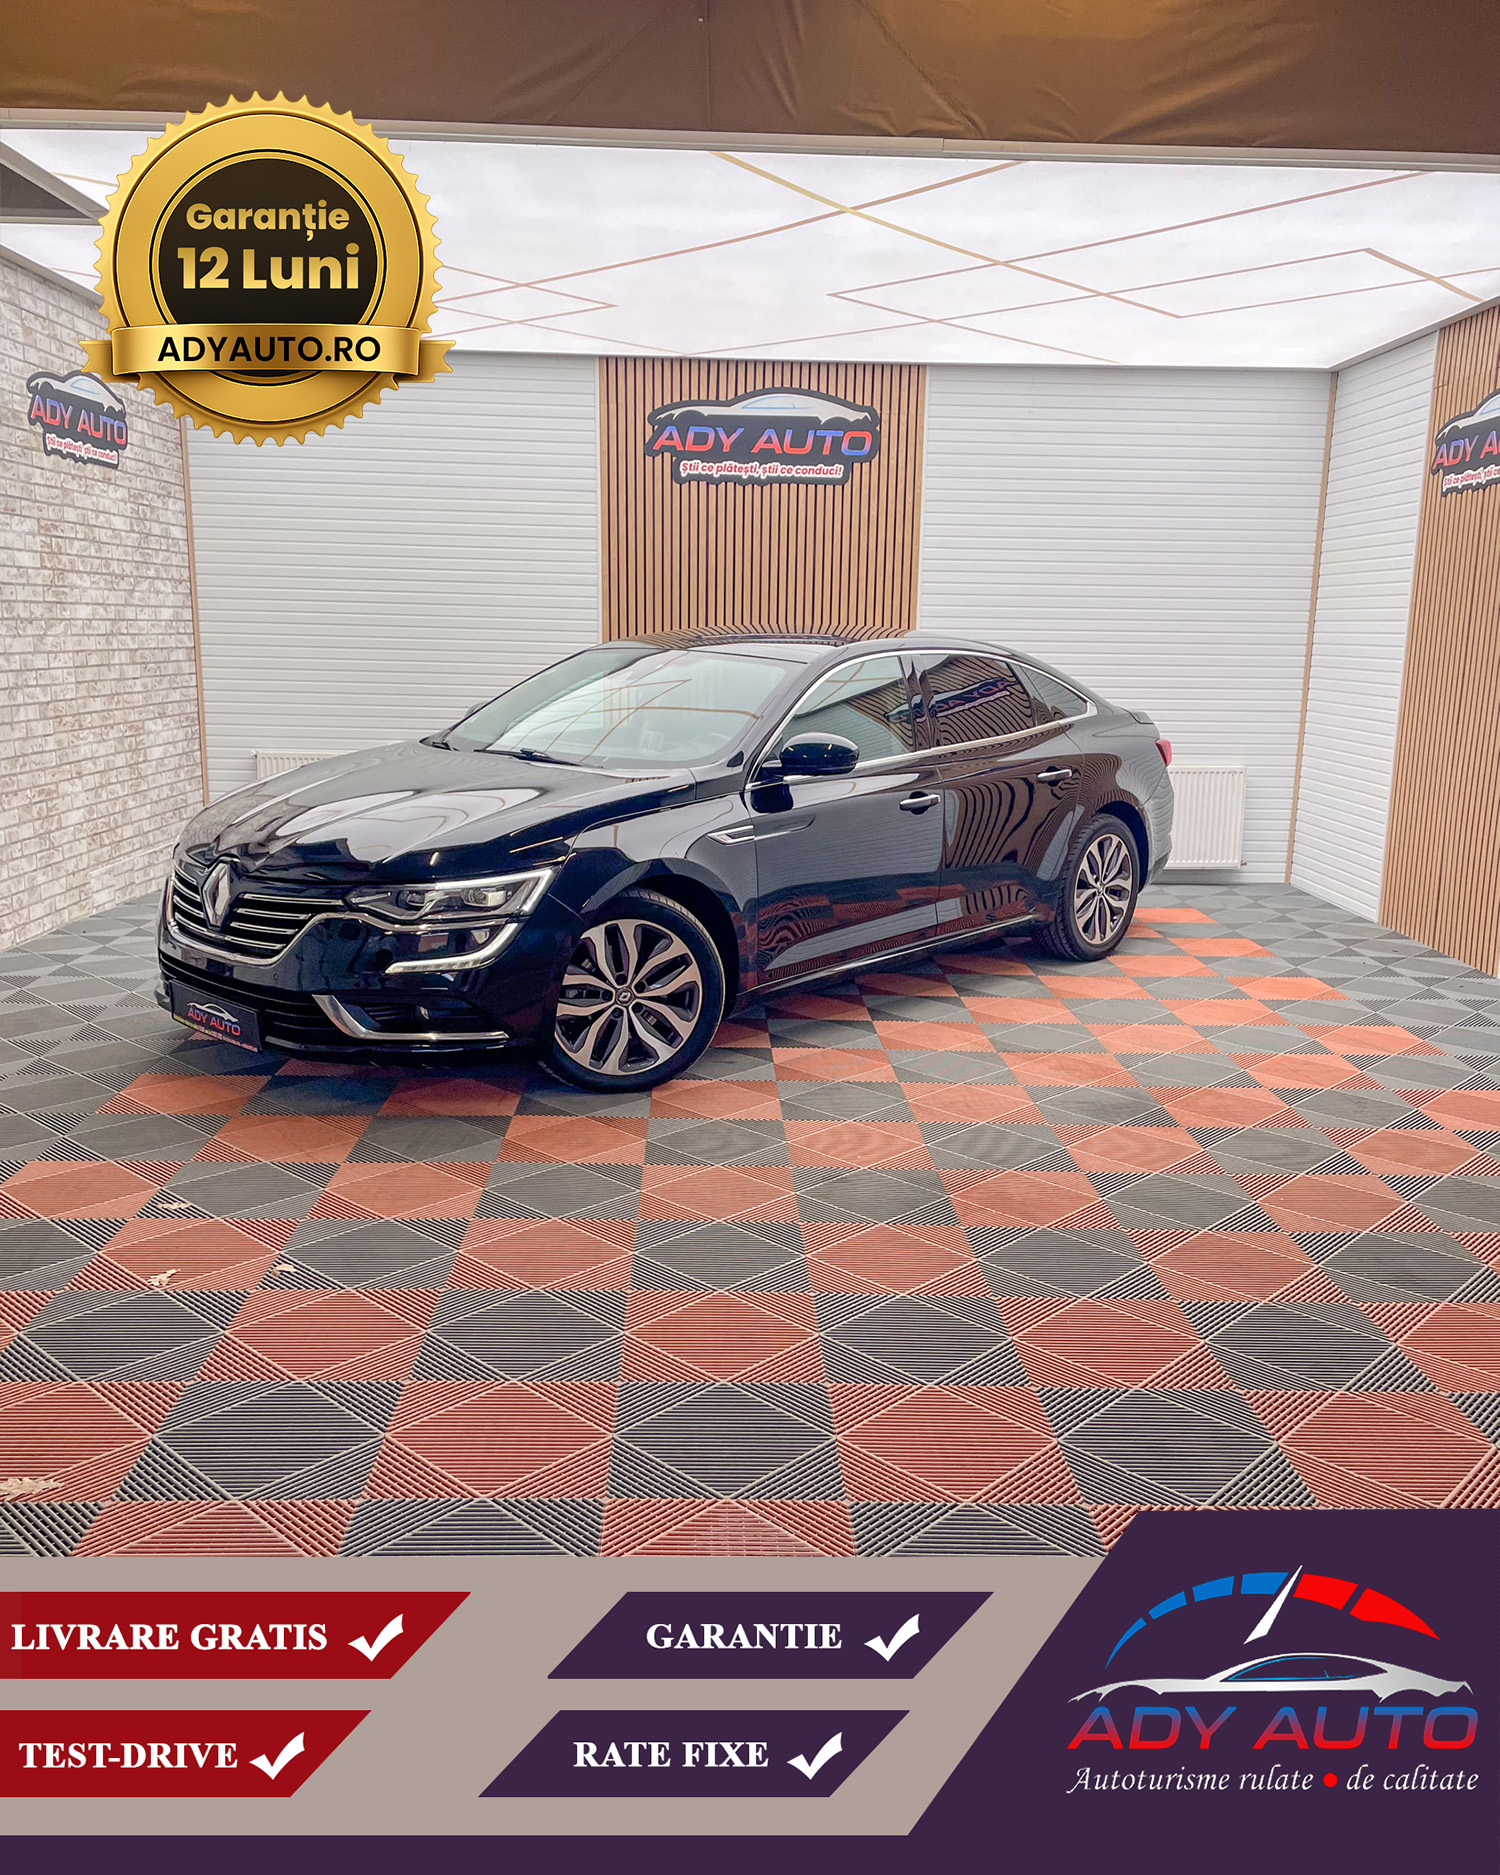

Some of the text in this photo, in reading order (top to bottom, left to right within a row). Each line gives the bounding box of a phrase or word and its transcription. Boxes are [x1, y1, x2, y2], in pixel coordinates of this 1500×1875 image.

[30, 394, 127, 445] ADY AUTO
[652, 425, 873, 456] ADY AUTO
[1432, 434, 1480, 470] ADY
[681, 462, 700, 475] Știi
[701, 465, 714, 473] ce
[761, 464, 779, 476] știi
[795, 464, 843, 476] conduci!
[187, 1007, 208, 1023] ADY
[209, 1016, 241, 1036] AUTO
